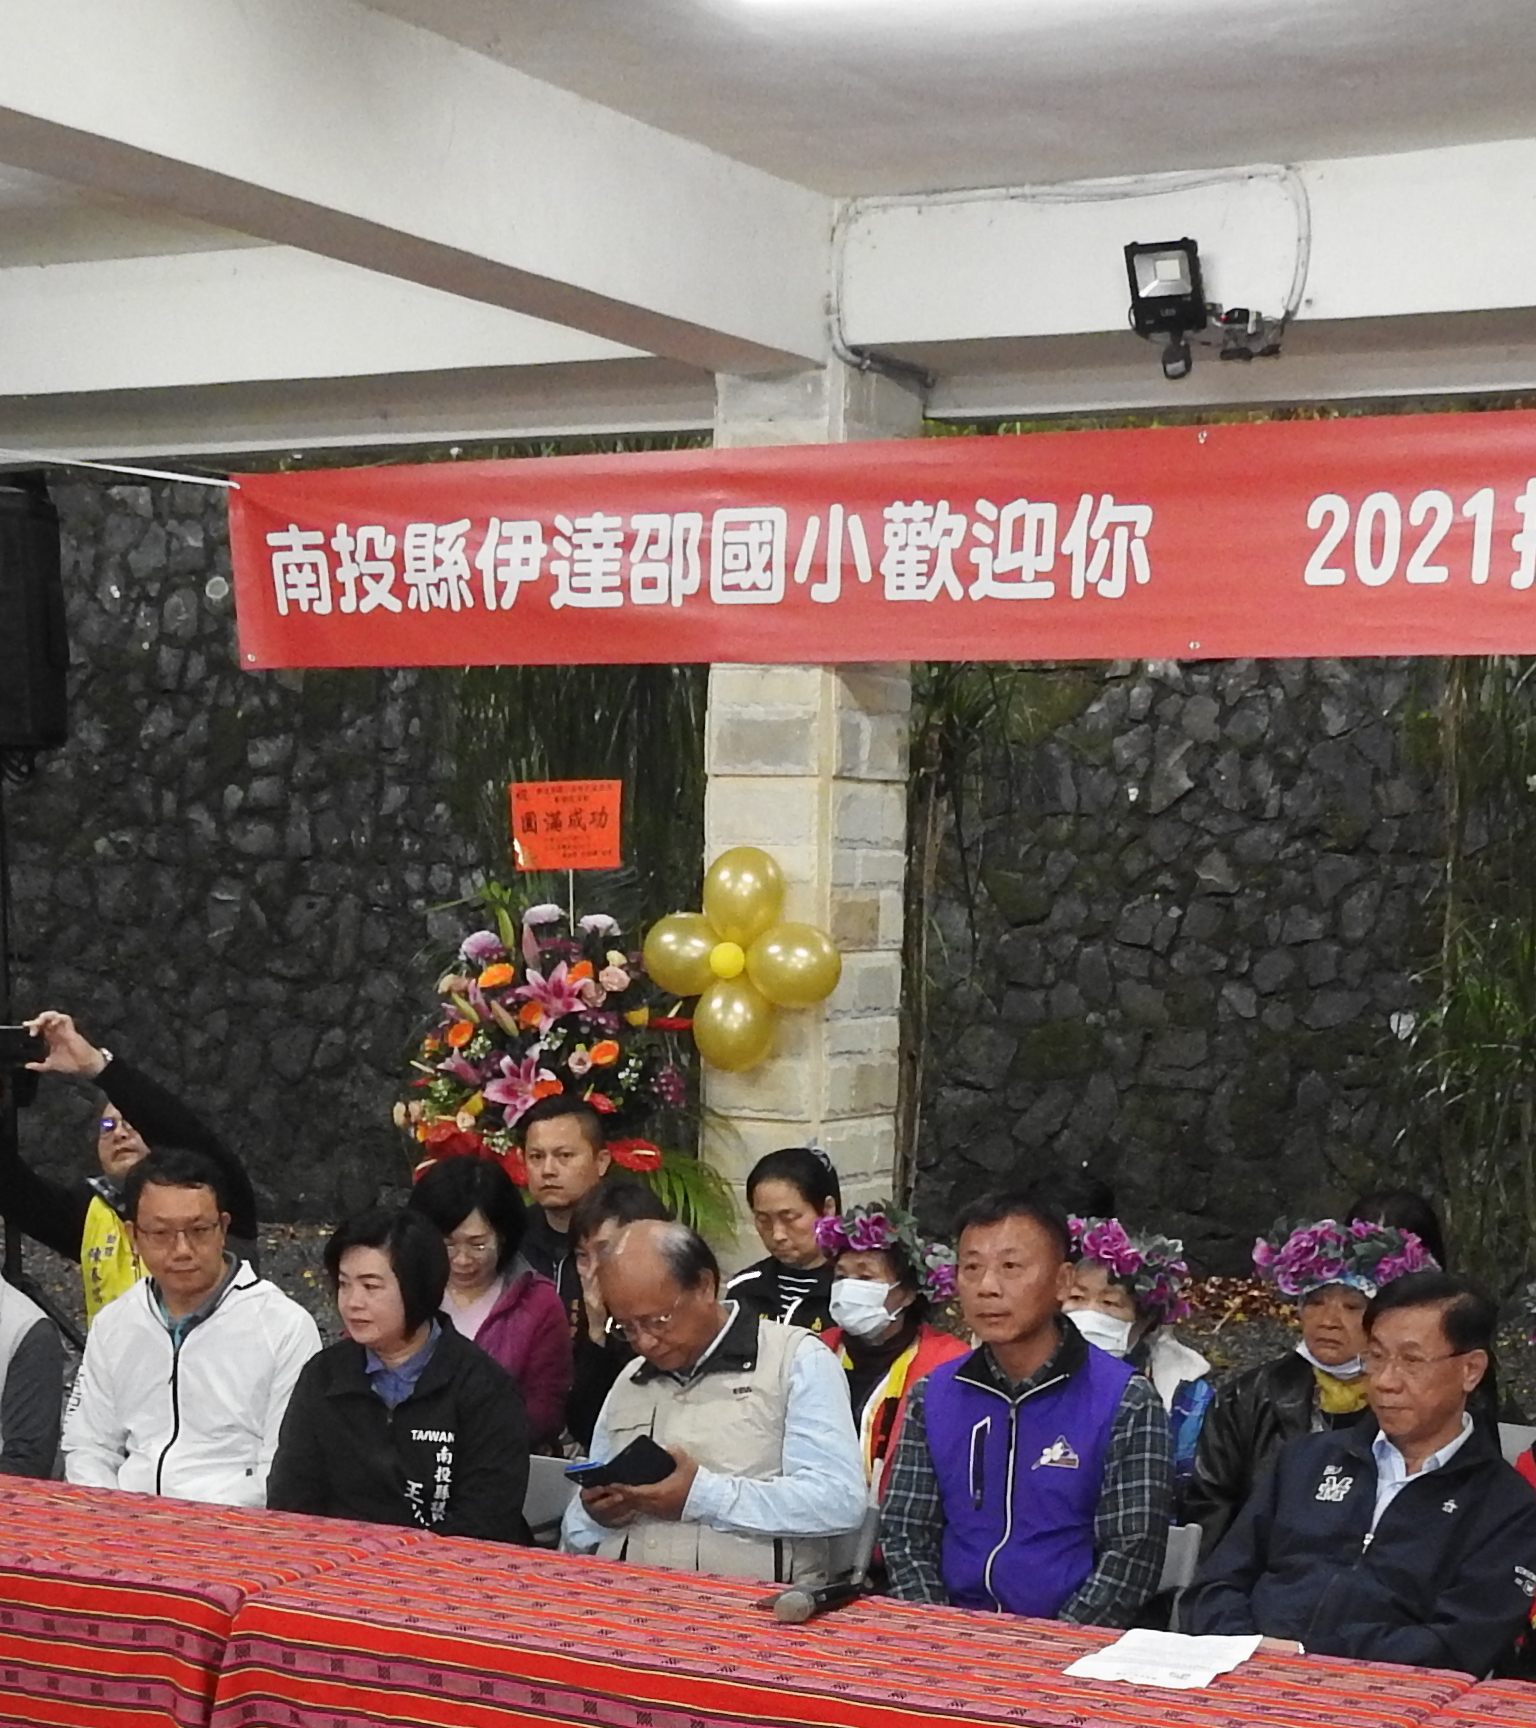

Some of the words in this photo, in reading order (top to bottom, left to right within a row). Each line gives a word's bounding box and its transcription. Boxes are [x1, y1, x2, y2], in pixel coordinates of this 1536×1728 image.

[265, 493, 1154, 615] 南投縣伊達邵國小歡迎你
[410, 1429, 455, 1443] TAIWAN
